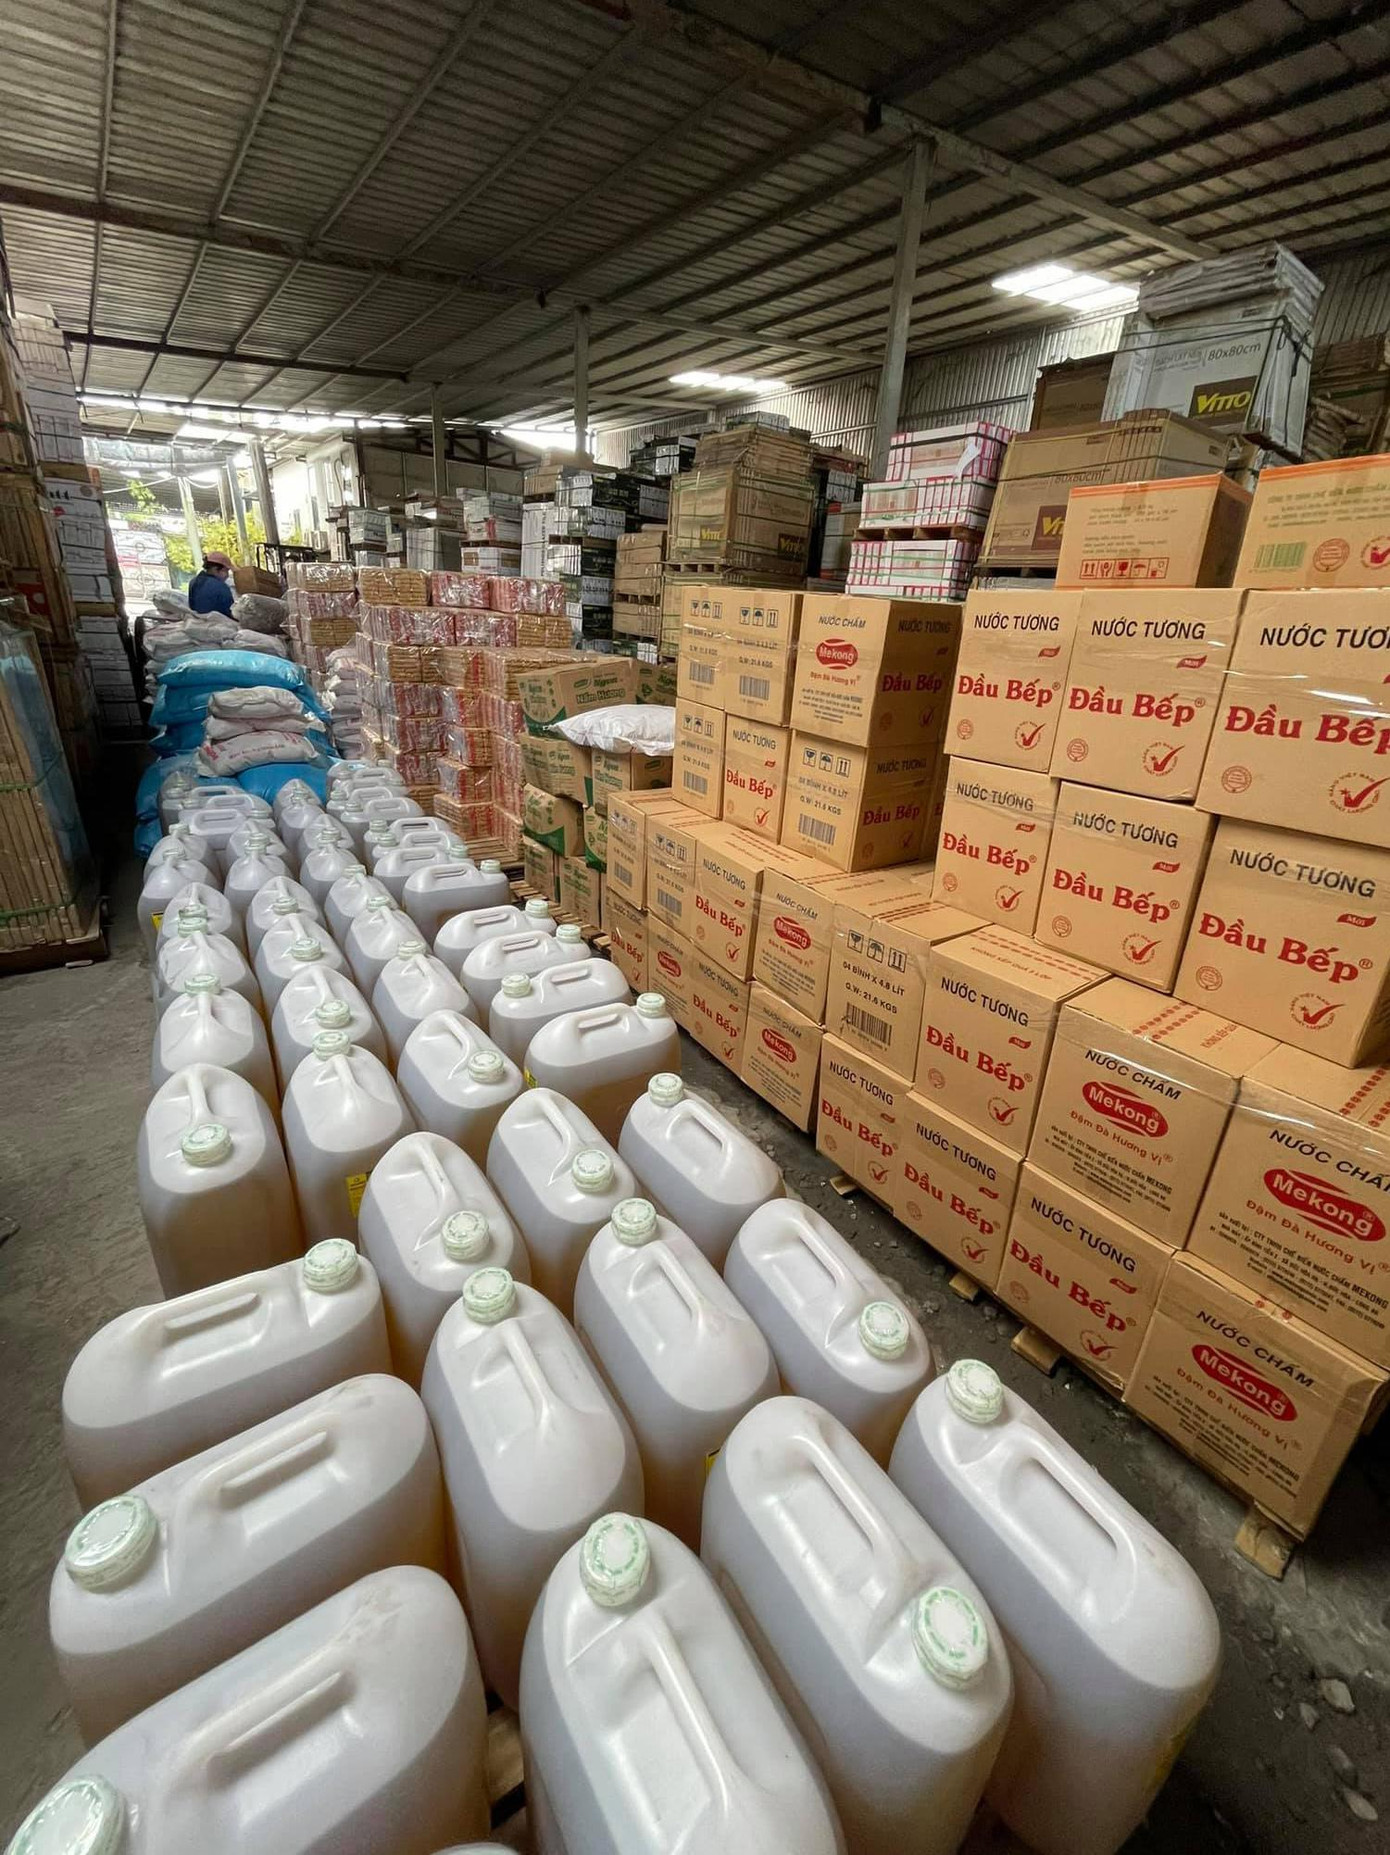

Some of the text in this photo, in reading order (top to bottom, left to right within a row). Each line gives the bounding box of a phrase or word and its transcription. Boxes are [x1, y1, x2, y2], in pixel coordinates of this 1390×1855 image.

[1208, 343, 1261, 361] 80x80cm
[1197, 391, 1251, 414] VITTO
[974, 611, 1060, 631] NƯỚC TƯƠNG
[1091, 616, 1206, 640] NƯỚC TƯƠNG
[1260, 623, 1390, 649] NƯỚC TƯƠ
[957, 673, 999, 699] Đầu
[1068, 686, 1123, 715] Đầu
[1225, 704, 1303, 739] Đầu
[726, 769, 773, 799] Đầu Bếp
[957, 783, 1034, 812] NƯỚC TƯƠNG
[942, 832, 980, 860] Đầu
[1073, 811, 1179, 849] NƯỚC TƯƠNG
[1052, 868, 1104, 902] Đầu
[1229, 849, 1377, 898] NƯỚC TƯƠNG
[695, 894, 743, 937] Đầu Bếp
[1198, 912, 1267, 955] Đầu
[941, 976, 1029, 1028] NƯỚC TƯƠNG
[926, 1025, 969, 1063] Đầu
[859, 1076, 894, 1106] TƯƠNG
[1085, 1049, 1182, 1100] NƯỚC CHẤM
[821, 1098, 893, 1157] Đầu Bếp
[1070, 1110, 1093, 1127] Đậm
[916, 1122, 997, 1182] NƯỚC TƯƠNG
[1269, 1129, 1390, 1192] NƯỚC CHẤ
[903, 1162, 994, 1235] Đầu Bếp
[1031, 1197, 1137, 1273] NƯỚC TƯƠNG
[1246, 1200, 1277, 1221] Đậm
[1281, 1217, 1300, 1235] Đà
[1305, 1230, 1354, 1264] Hương
[1010, 1238, 1126, 1332] Đầu Bếp
[1352, 1284, 1389, 1309] MEKONG
[1196, 1310, 1315, 1388] NƯỚC CHẤM
[1200, 1349, 1286, 1417] Mekong
[1176, 1367, 1204, 1391] Đậm
[1227, 1398, 1271, 1438] Hương
